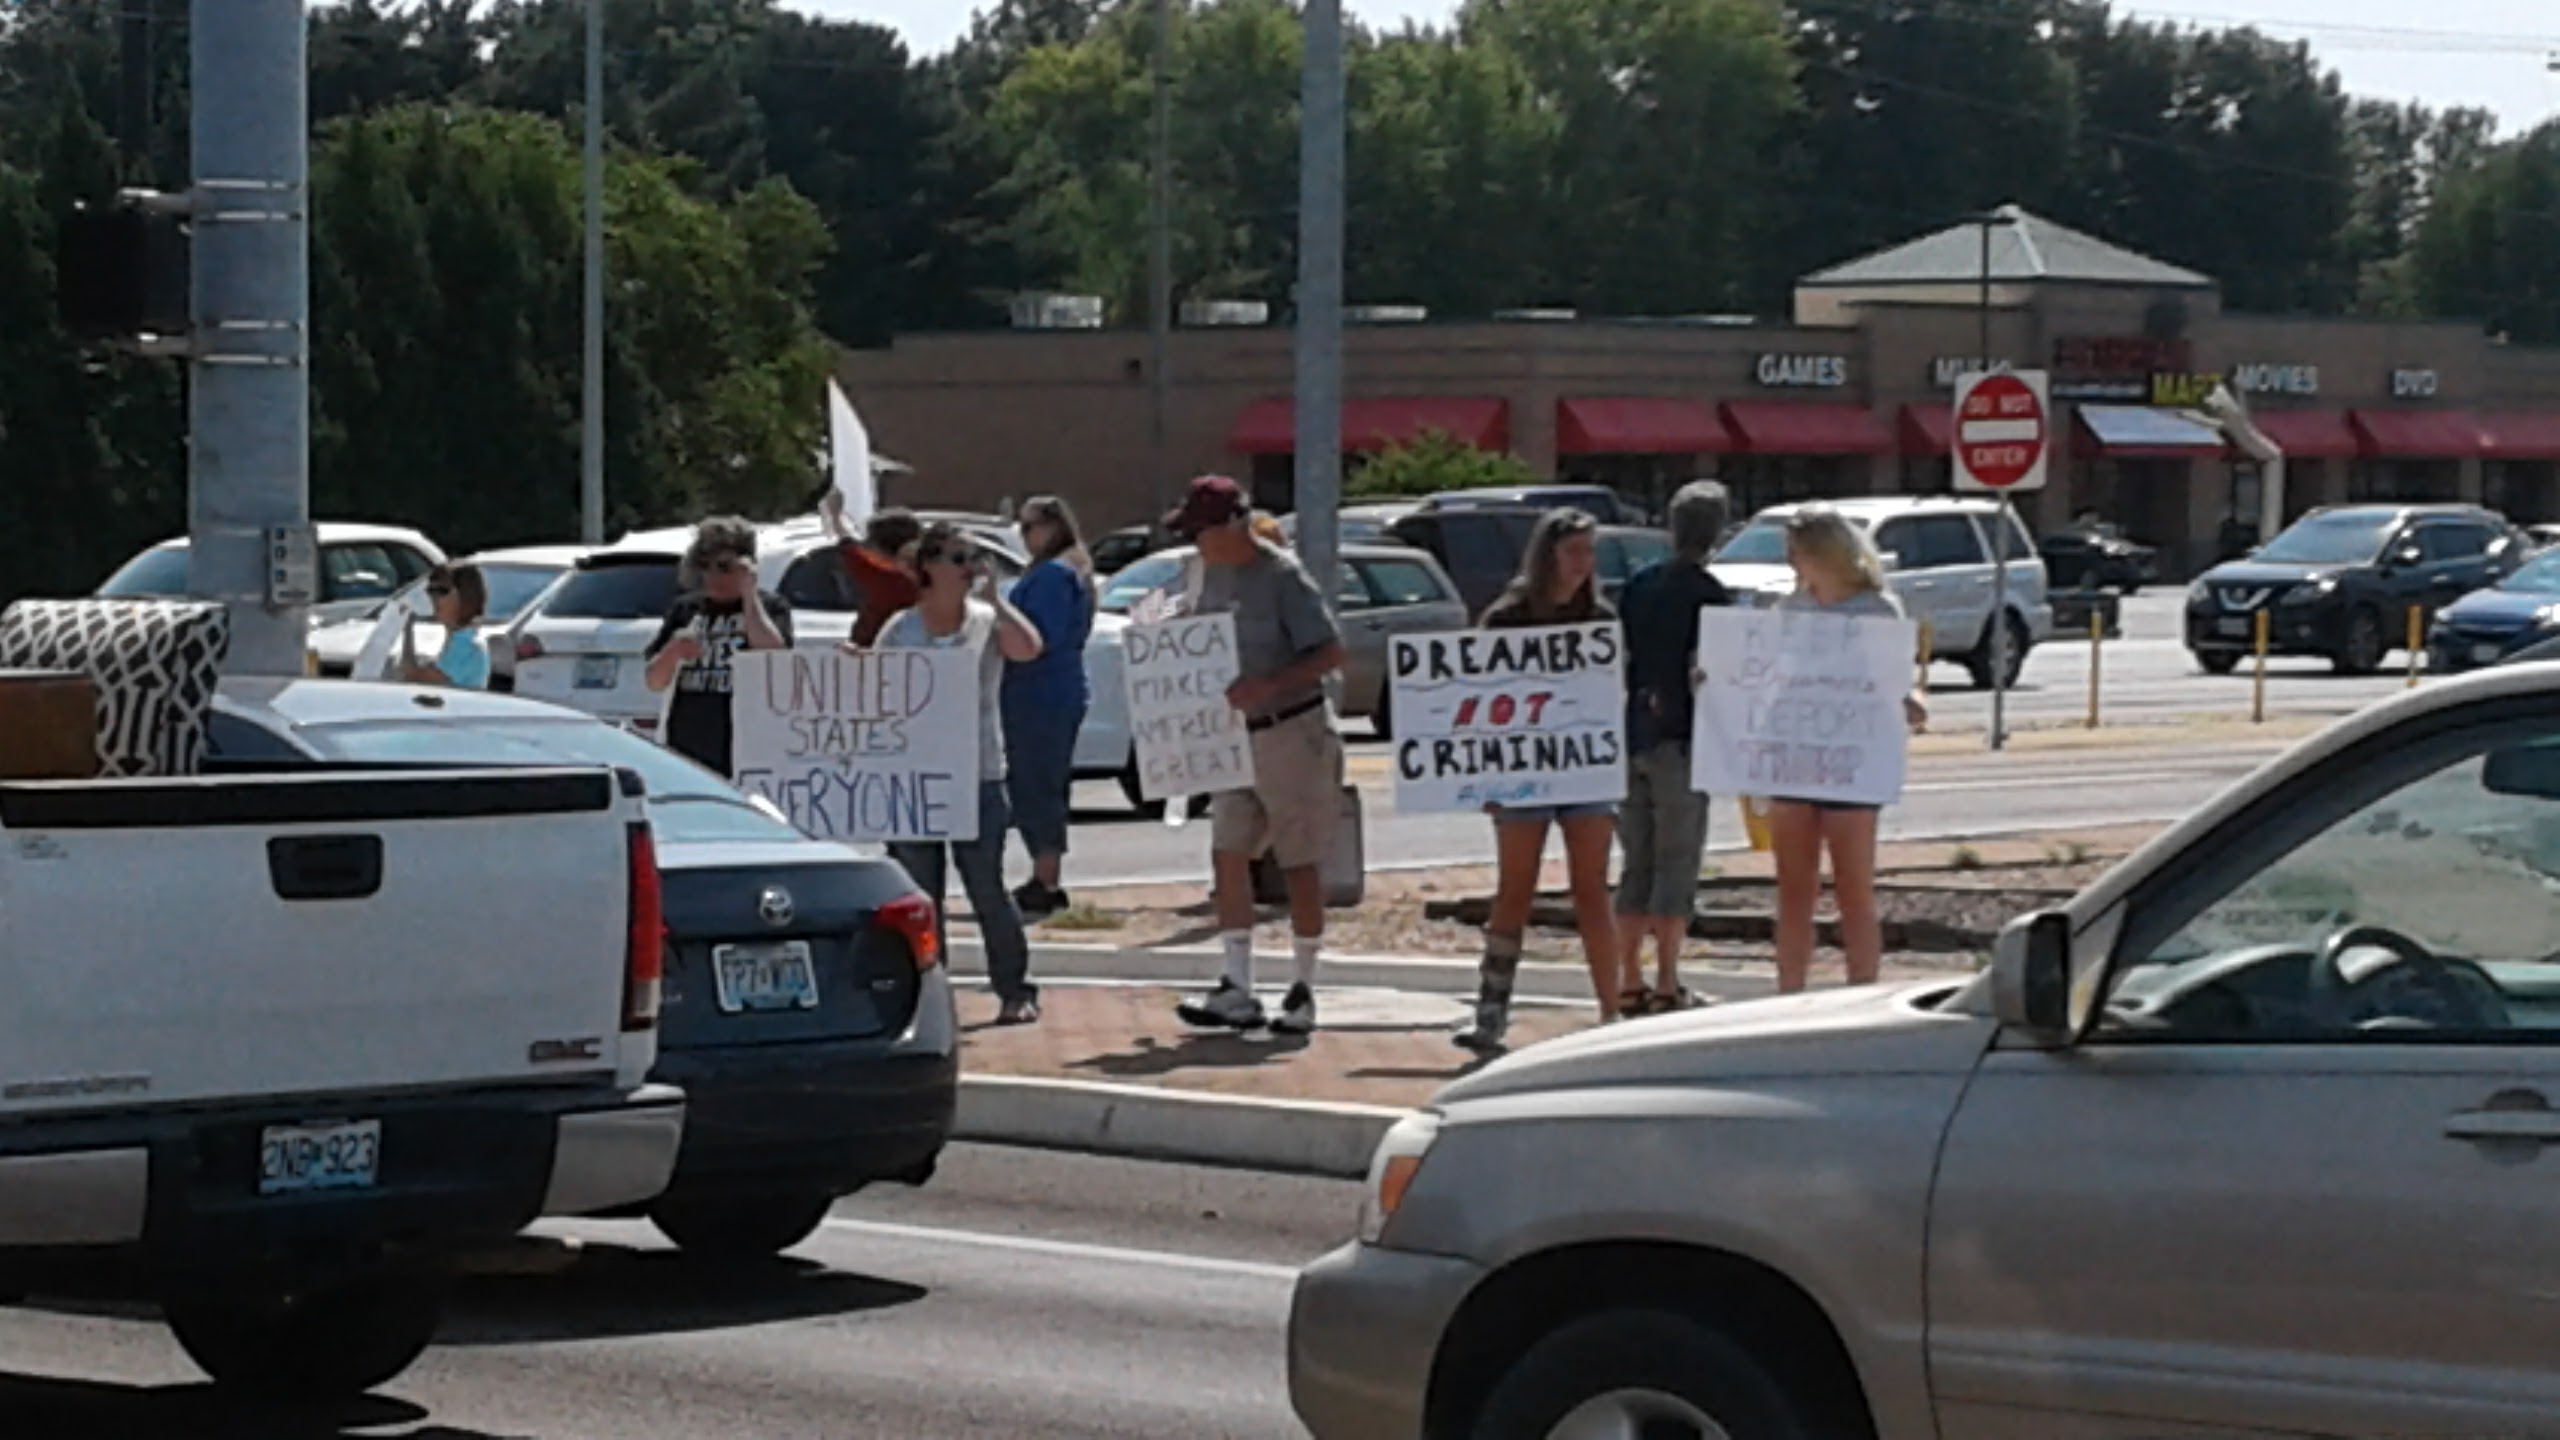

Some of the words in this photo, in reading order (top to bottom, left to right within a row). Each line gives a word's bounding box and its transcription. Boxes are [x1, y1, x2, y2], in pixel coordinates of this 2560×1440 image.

[1757, 355, 1846, 386] GAMES
[2235, 363, 2319, 394] MOVIES
[2394, 368, 2438, 396] DVD
[1967, 396, 1992, 415] DO
[1999, 393, 2033, 413] NOT
[1971, 445, 2028, 468] ENTER
[1125, 622, 1229, 666] DACA
[1396, 626, 1618, 680] DREAMERS
[765, 651, 935, 718] UNITED
[1453, 691, 1554, 728] NOT
[785, 716, 909, 757] STATES
[1399, 730, 1619, 780] CRIMINALS
[529, 1037, 603, 1063] GMC
